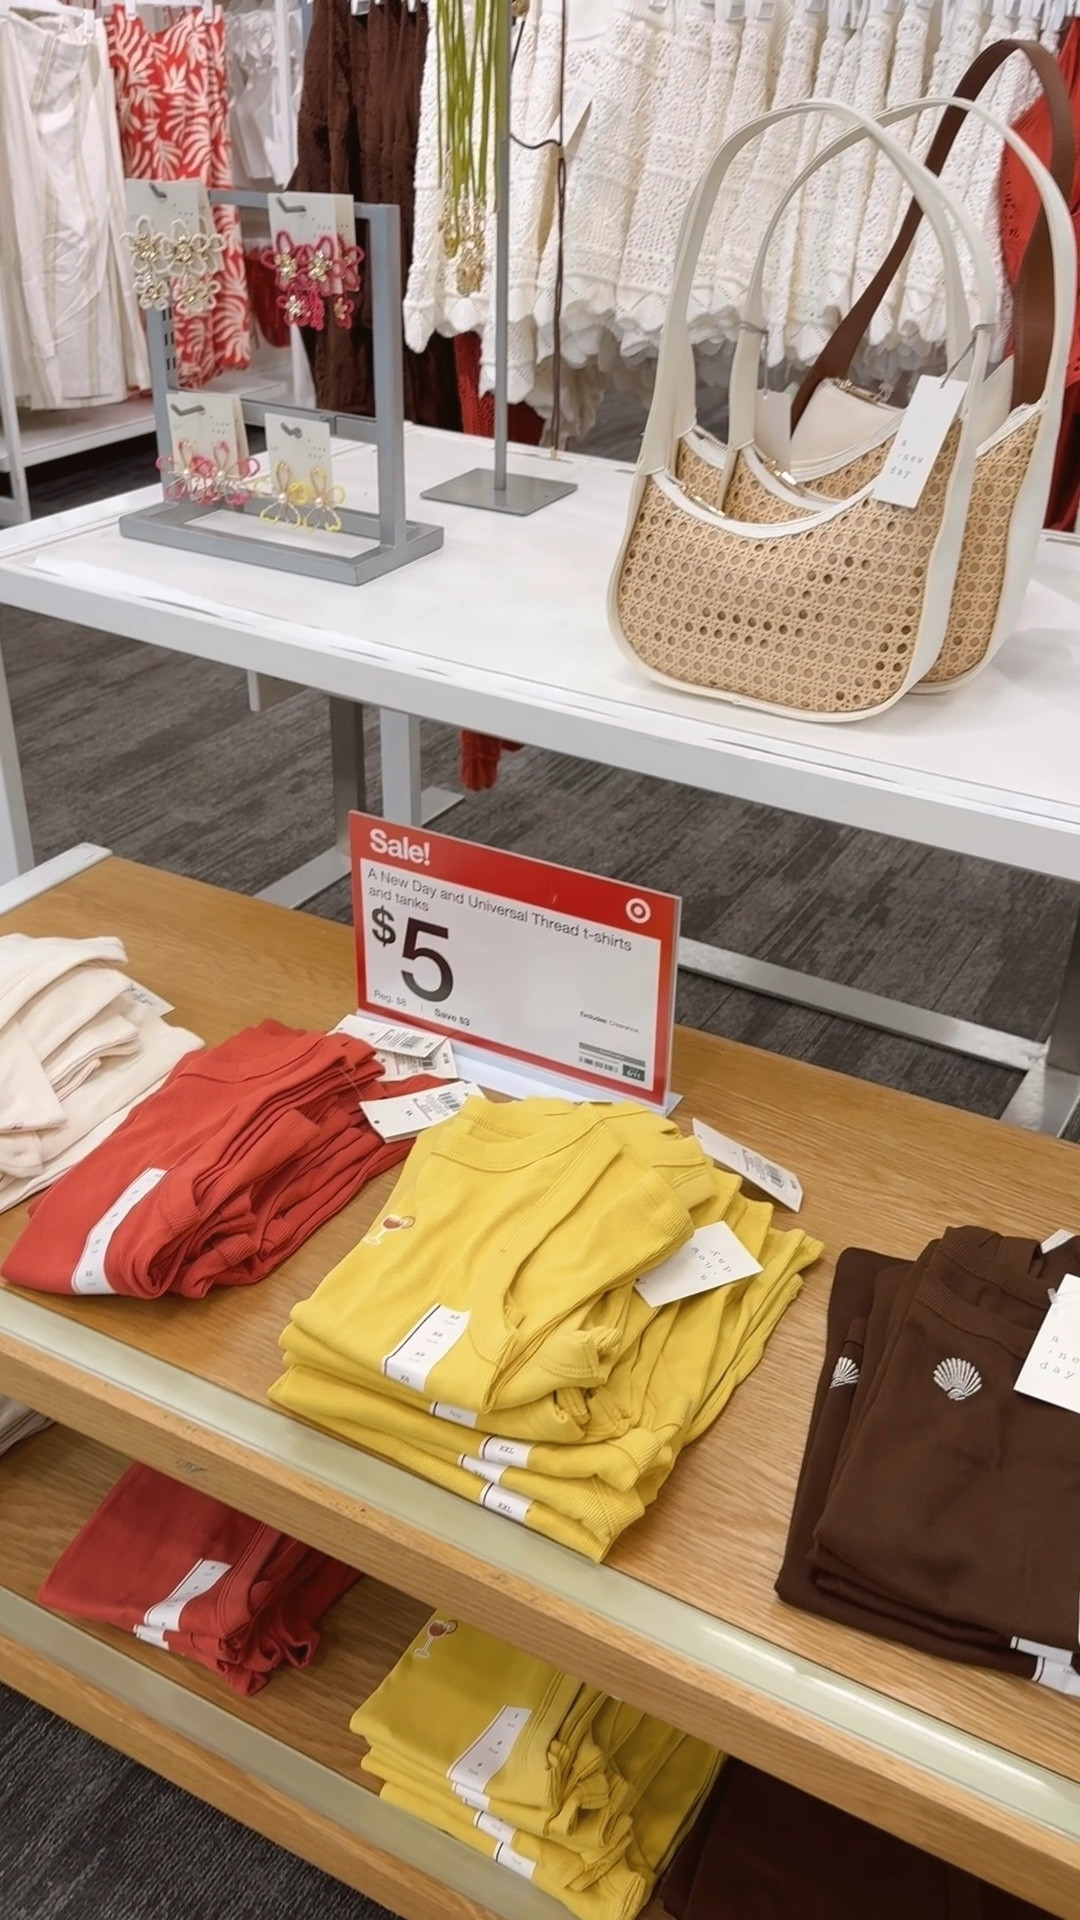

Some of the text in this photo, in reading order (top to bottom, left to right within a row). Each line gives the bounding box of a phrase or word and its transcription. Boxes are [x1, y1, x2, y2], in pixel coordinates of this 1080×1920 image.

[369, 828, 431, 866] Sale!
[368, 886, 430, 912] and tanks
[367, 867, 633, 952] A New Day and Universal Thread t-shirts
[370, 905, 455, 1003] $5
[433, 1007, 458, 1023] Save
[710, 1250, 732, 1273] day
[1051, 1335, 1059, 1343] a
[1039, 1361, 1077, 1379] day
[498, 1444, 516, 1455] XXL
[496, 1501, 513, 1514] XXL
